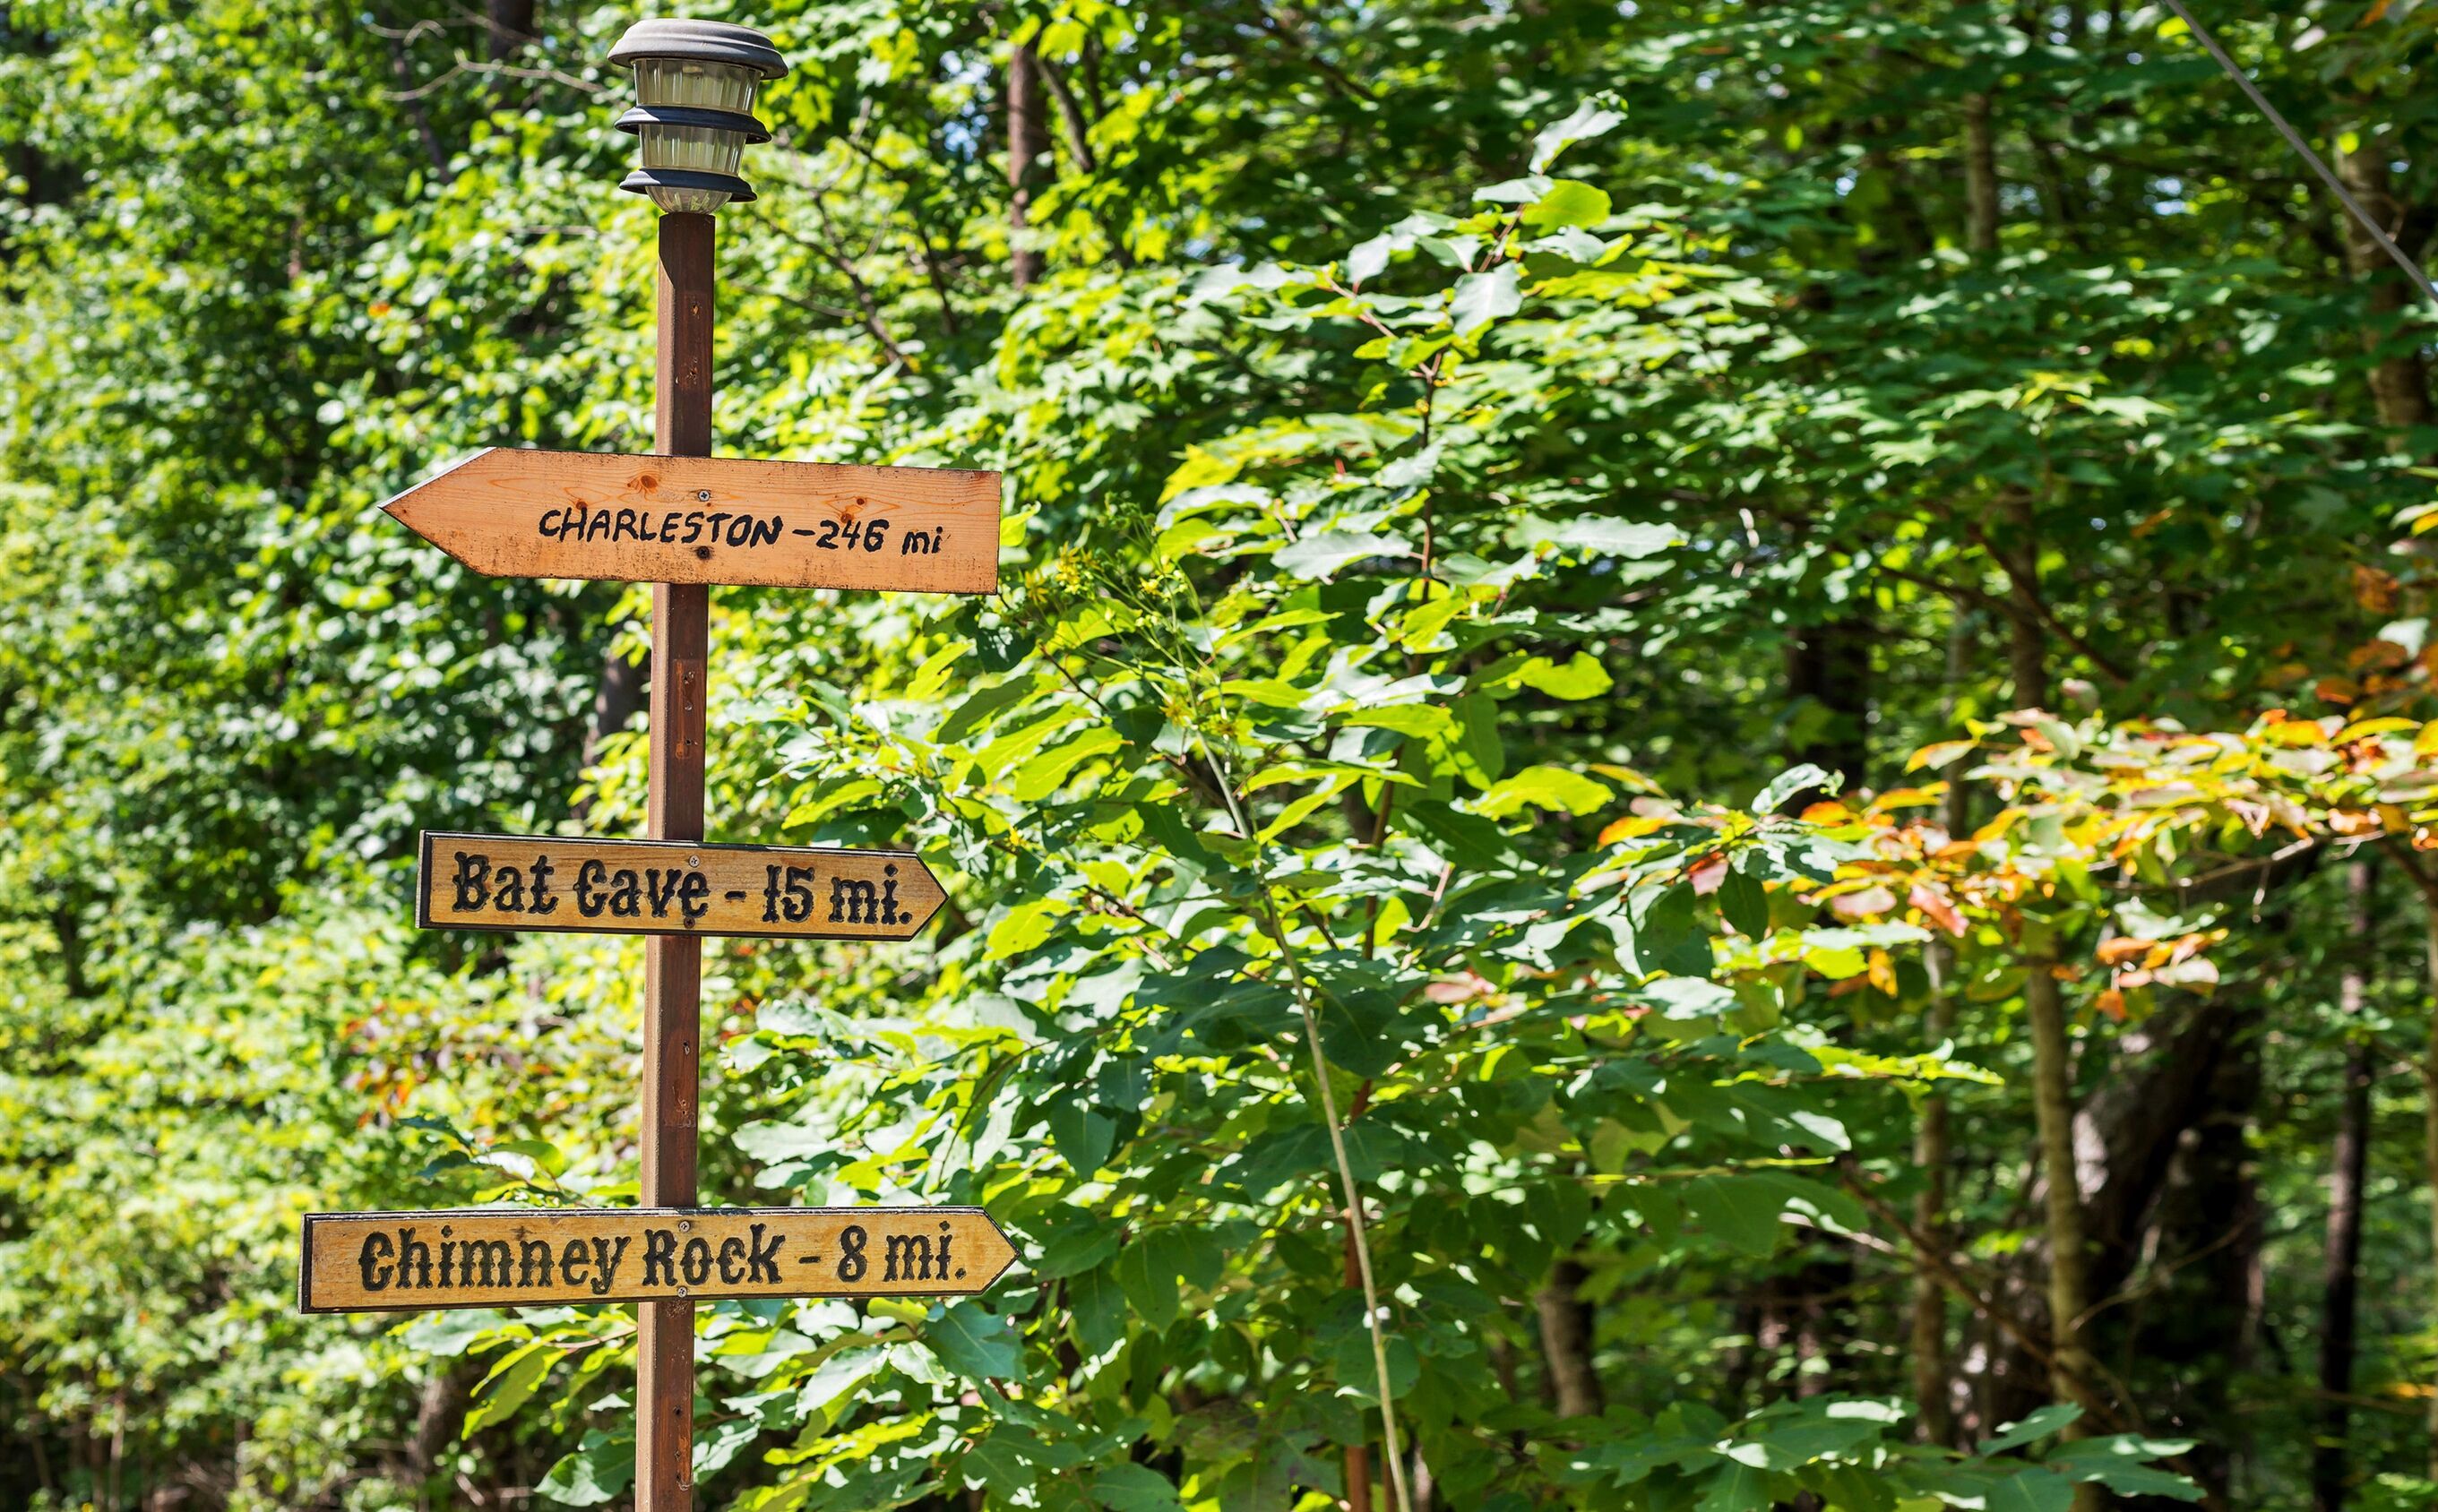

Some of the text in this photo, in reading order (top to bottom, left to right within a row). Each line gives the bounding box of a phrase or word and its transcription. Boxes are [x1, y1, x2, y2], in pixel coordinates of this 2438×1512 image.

[538, 506, 784, 548] CHARLESTON
[900, 526, 944, 555] mi
[452, 851, 558, 915] Bat
[573, 858, 711, 918] Cave
[762, 863, 815, 924] 15
[829, 863, 914, 925] mi.
[358, 1224, 632, 1294] Chimney
[642, 1224, 786, 1287] Rock
[837, 1224, 868, 1283] 8
[883, 1220, 968, 1282] mi.
